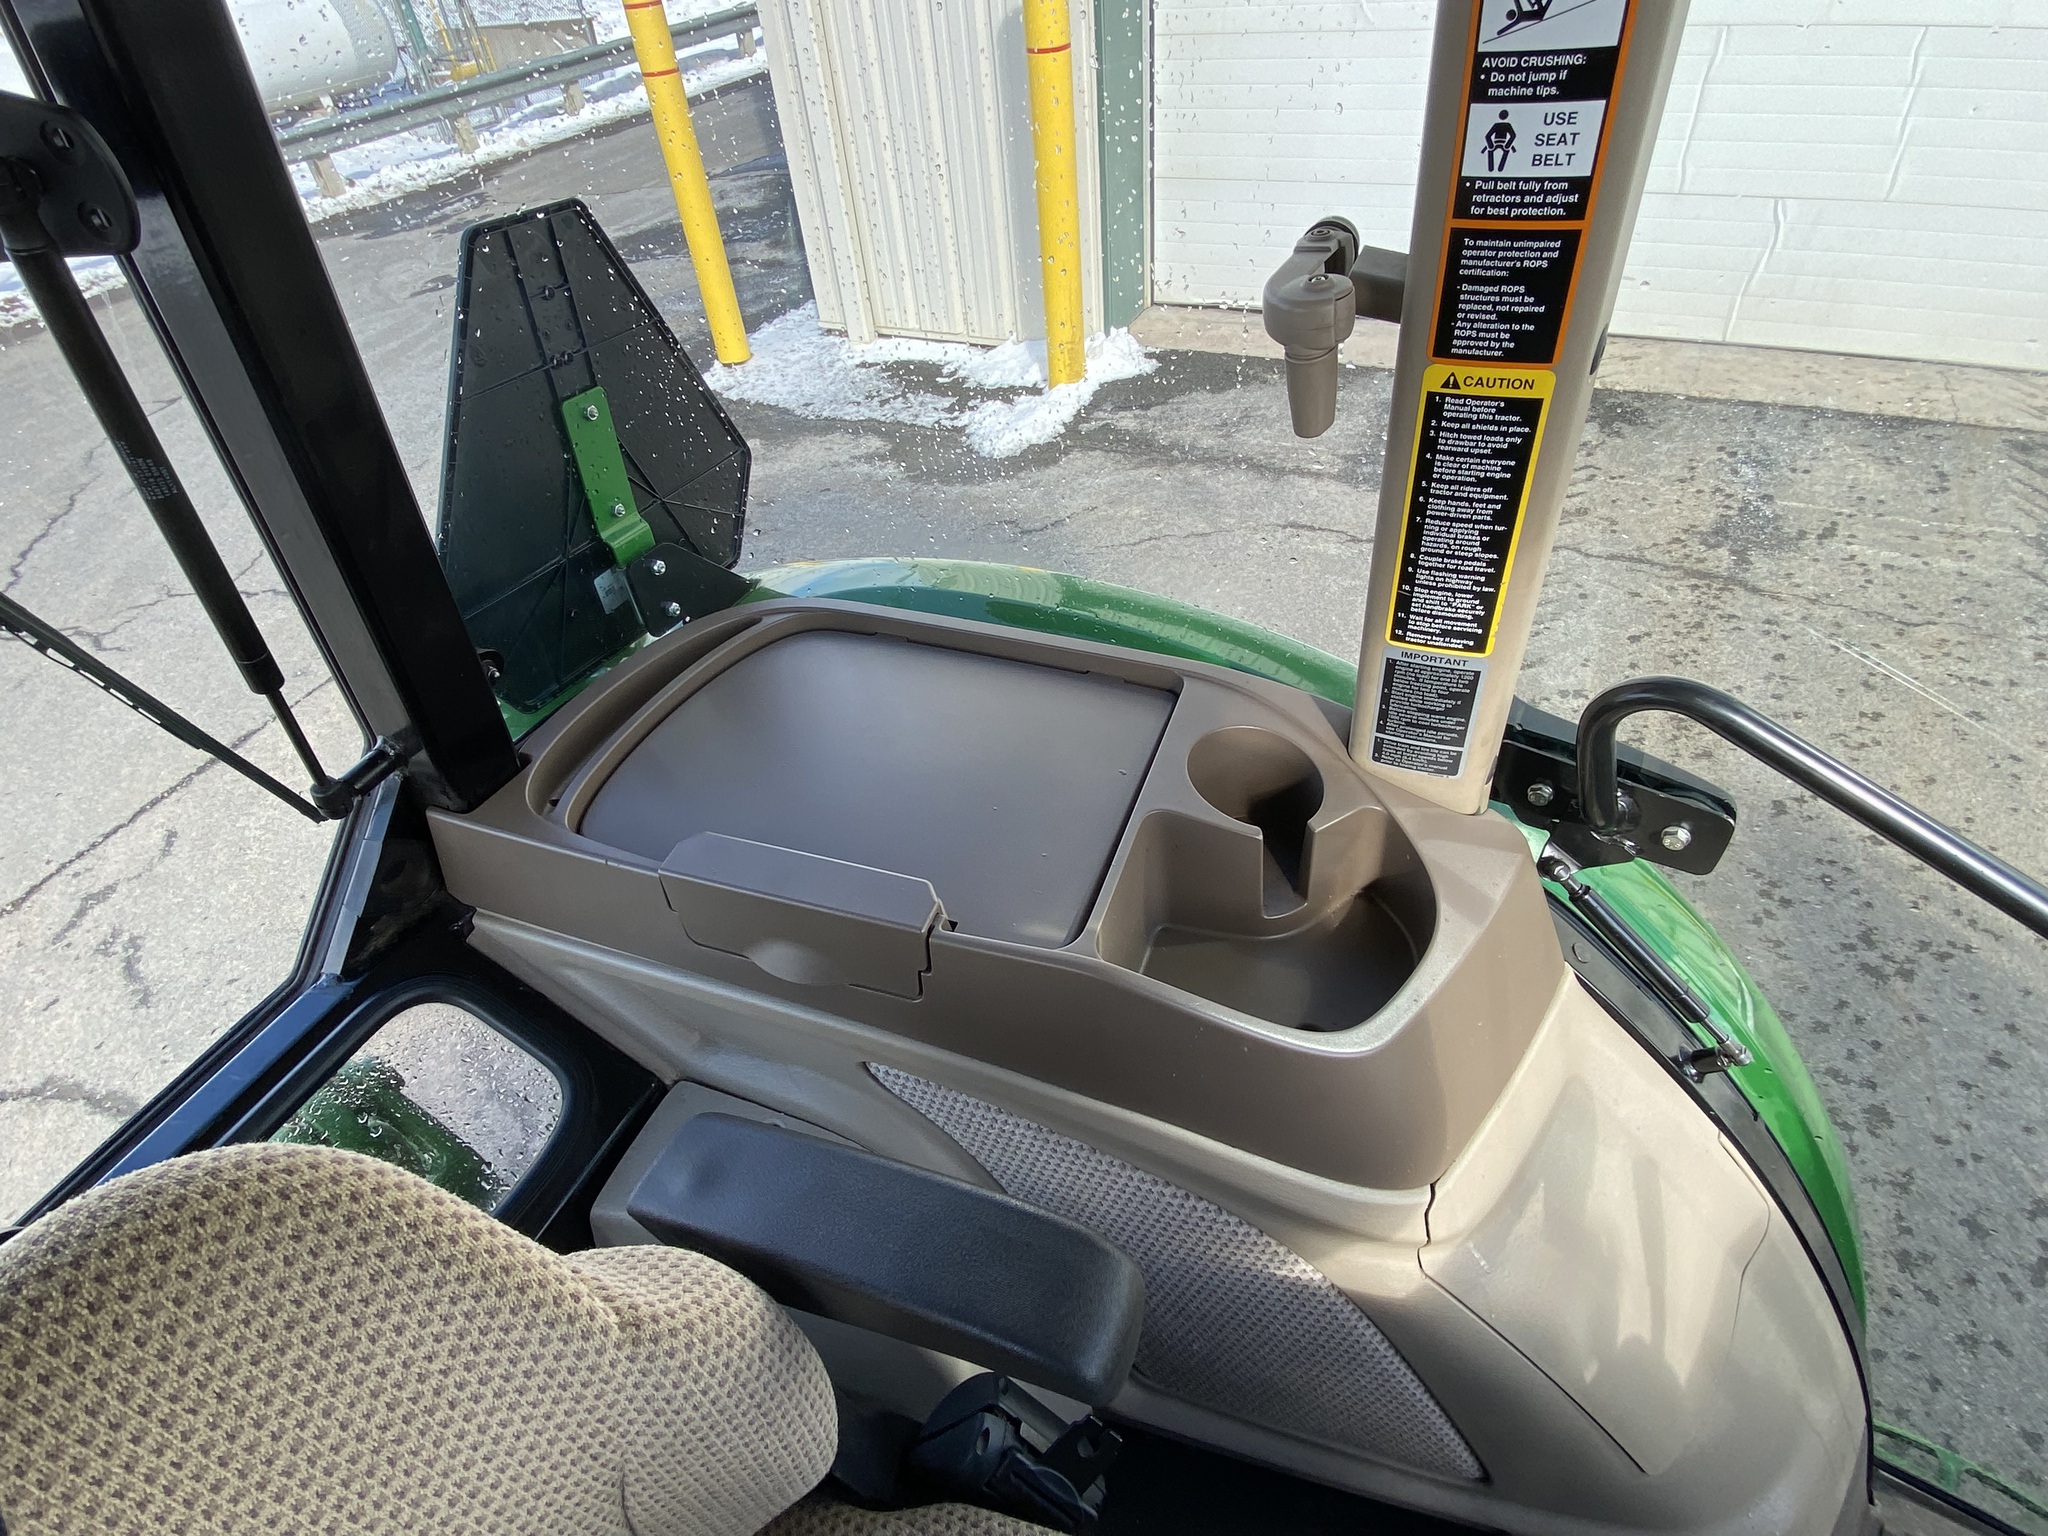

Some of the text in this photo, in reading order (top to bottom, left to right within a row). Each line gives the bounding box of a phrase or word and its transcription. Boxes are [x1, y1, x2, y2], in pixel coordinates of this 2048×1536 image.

[1482, 54, 1587, 68] AVOID CRUSHING:
[1490, 70, 1567, 83] Do not jump if
[1488, 86, 1560, 97] machine tips.
[1543, 112, 1578, 125] USE
[1534, 133, 1580, 146] SEAT
[1531, 153, 1575, 166] BELT
[1475, 180, 1568, 192] Pull belt fully from
[1472, 193, 1578, 204] retractors and adjust
[1471, 207, 1566, 218] for best protection.
[1464, 238, 1561, 249] To maintain unimpaired
[1462, 250, 1559, 259] operator protection and
[1461, 259, 1521, 267] manufacturer's
[1459, 269, 1509, 277] certification:
[1462, 284, 1525, 294] Damaged ROPS
[1460, 294, 1500, 302] structures
[1458, 304, 1494, 312] replaced,
[1511, 305, 1545, 313] repaired
[1467, 313, 1498, 321] revised.
[1456, 321, 1471, 329] Any
[1473, 322, 1510, 330] alteration
[1522, 323, 1535, 331] the
[1452, 340, 1488, 348] approved
[1490, 341, 1500, 349] by
[1451, 348, 1504, 356] manufacturer.
[1463, 376, 1535, 390] CAUTION
[1401, 651, 1468, 666] IMPORTANT
